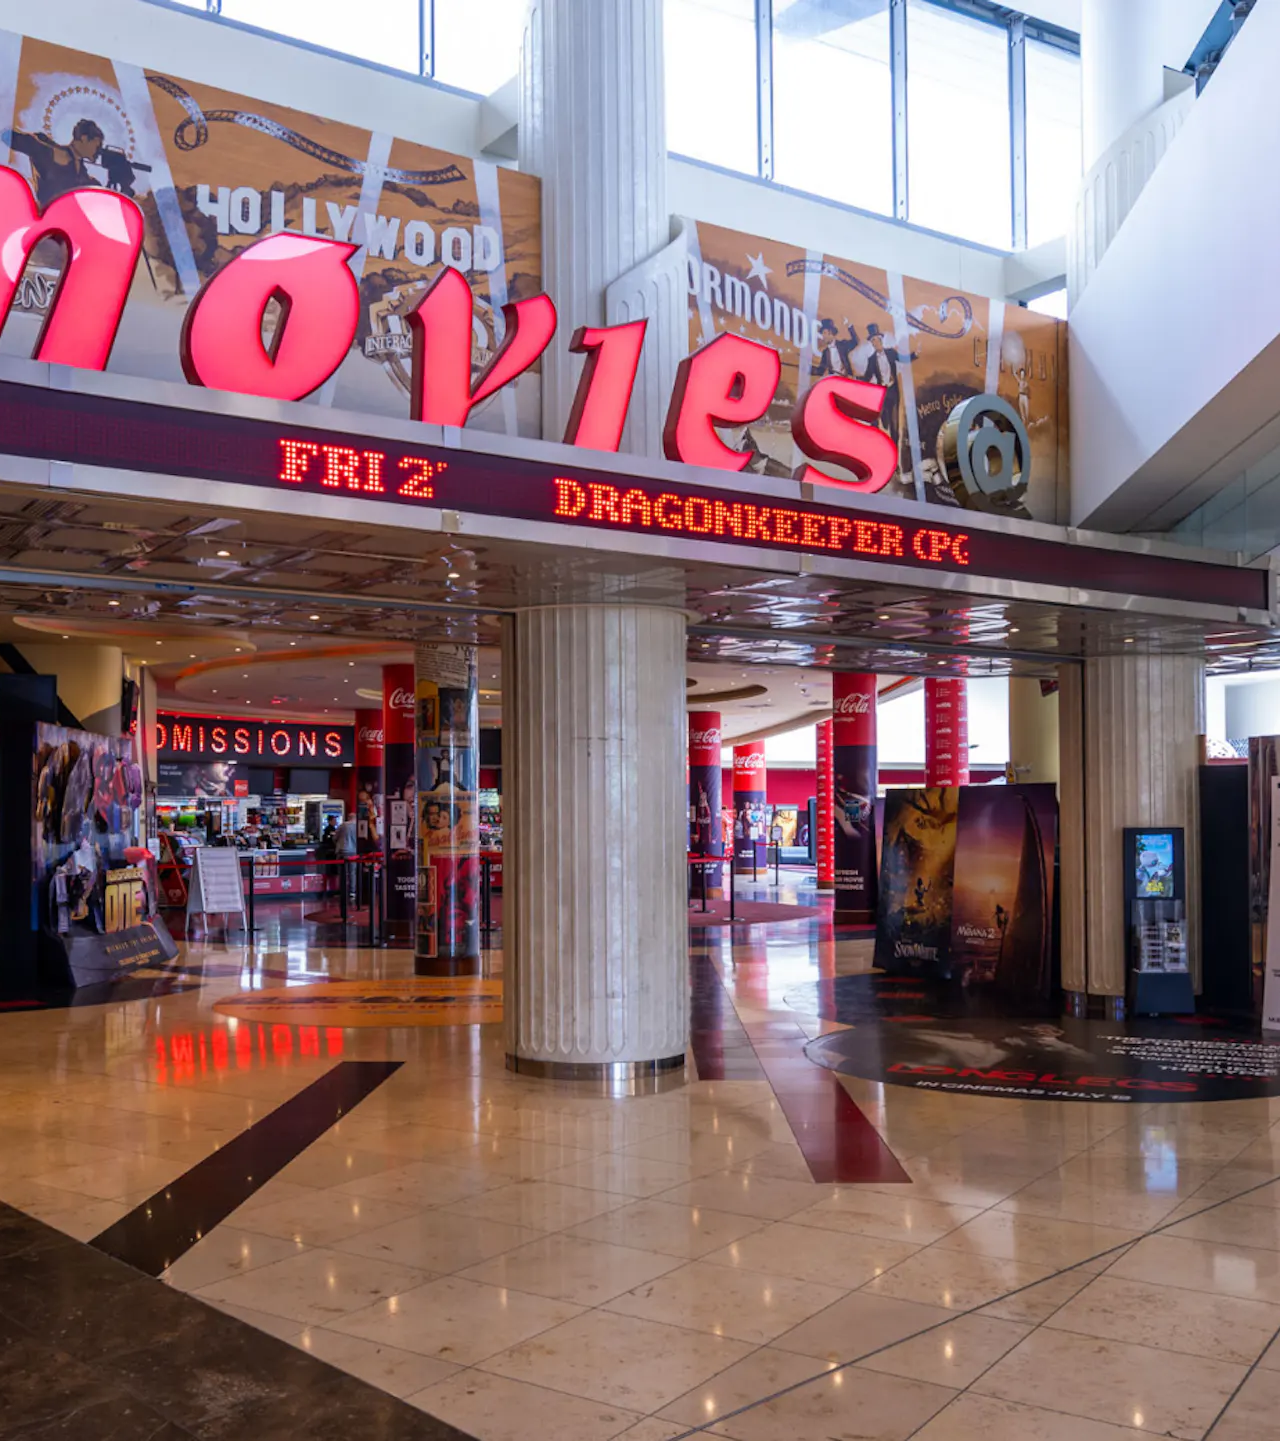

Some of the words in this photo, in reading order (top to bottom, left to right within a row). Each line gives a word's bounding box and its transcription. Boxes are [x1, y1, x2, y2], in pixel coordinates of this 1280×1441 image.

[196, 183, 504, 273] HOLLYWOOD
[278, 437, 385, 493] FRI
[397, 456, 448, 499] 2
[553, 477, 904, 558] DRAGONKEEPER
[130, 720, 342, 757] DMISSIONS
